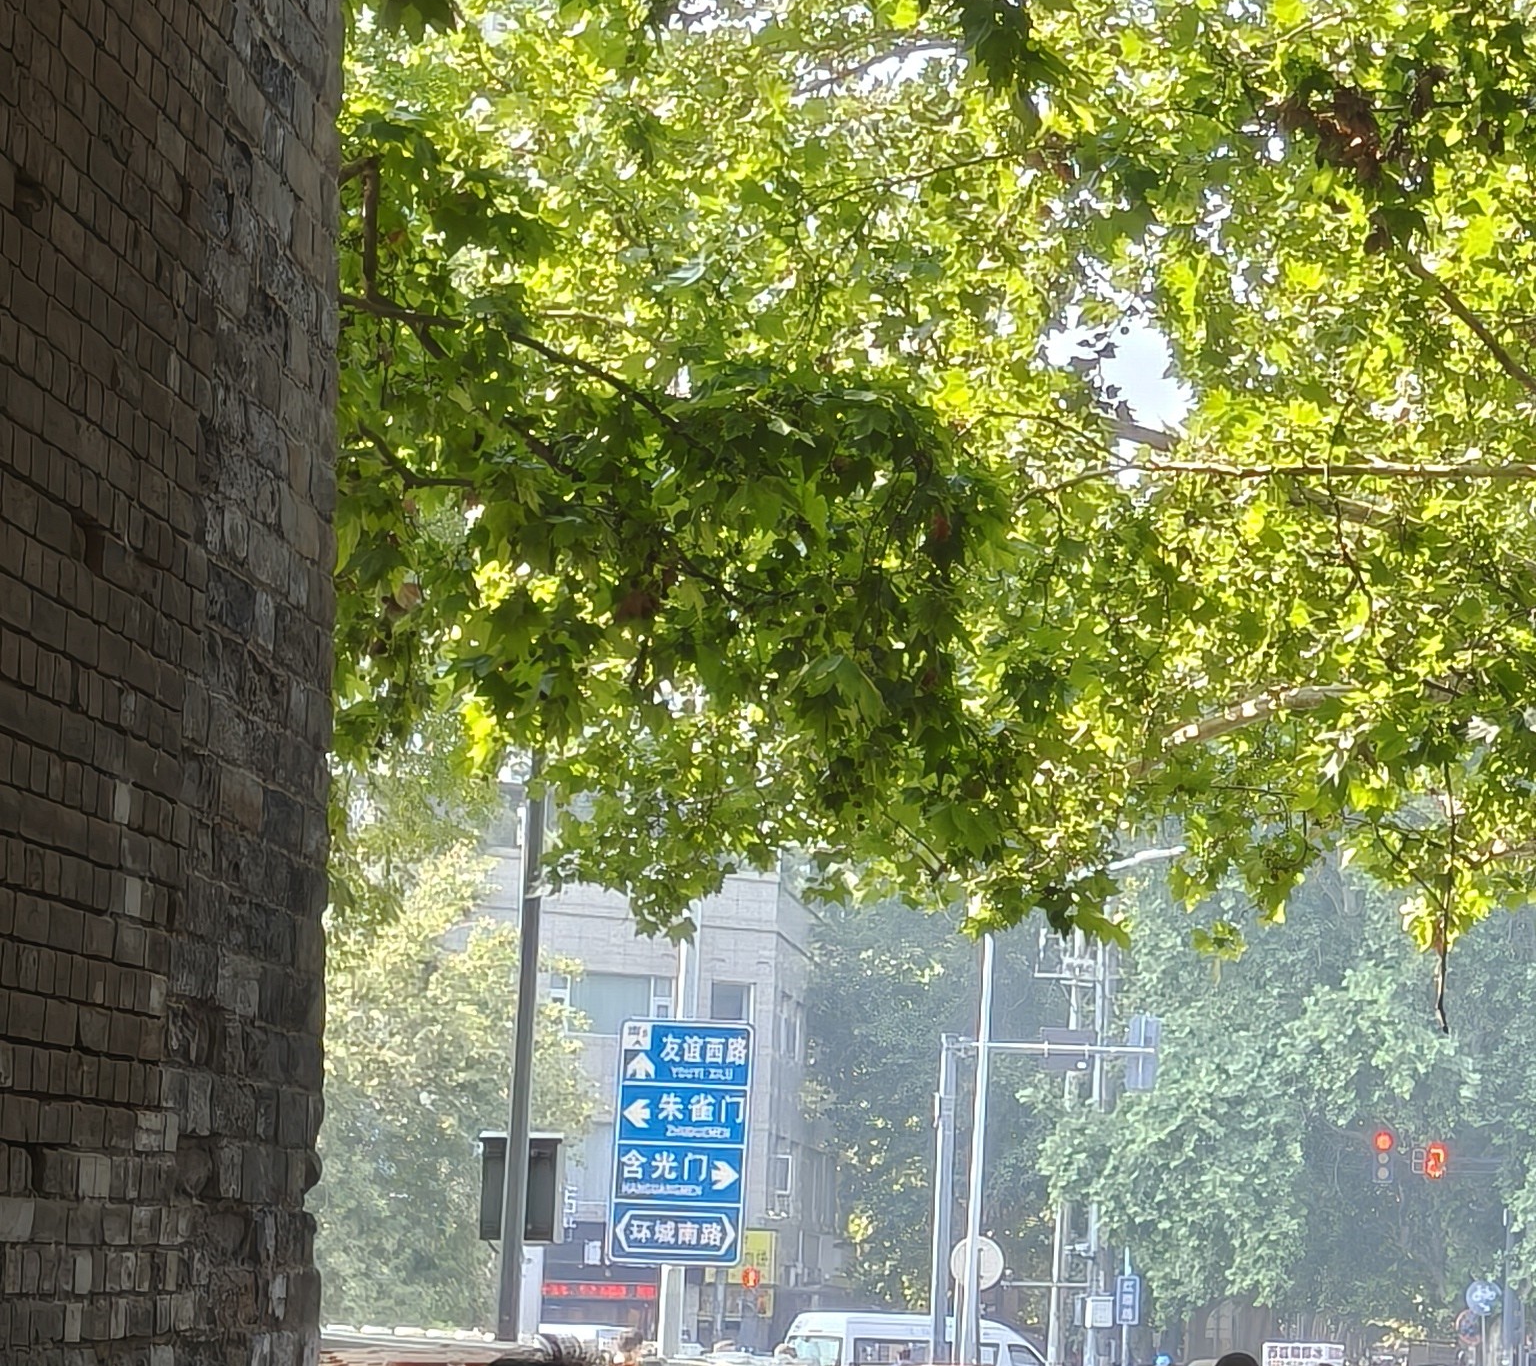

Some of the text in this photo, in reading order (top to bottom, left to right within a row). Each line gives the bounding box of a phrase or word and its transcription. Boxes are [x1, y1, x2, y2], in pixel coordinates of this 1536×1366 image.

[660, 1033, 748, 1065] 友谊西路
[658, 1092, 746, 1124] 朱雀门
[620, 1148, 709, 1182] 含光门
[628, 1219, 723, 1247] 环城南路
